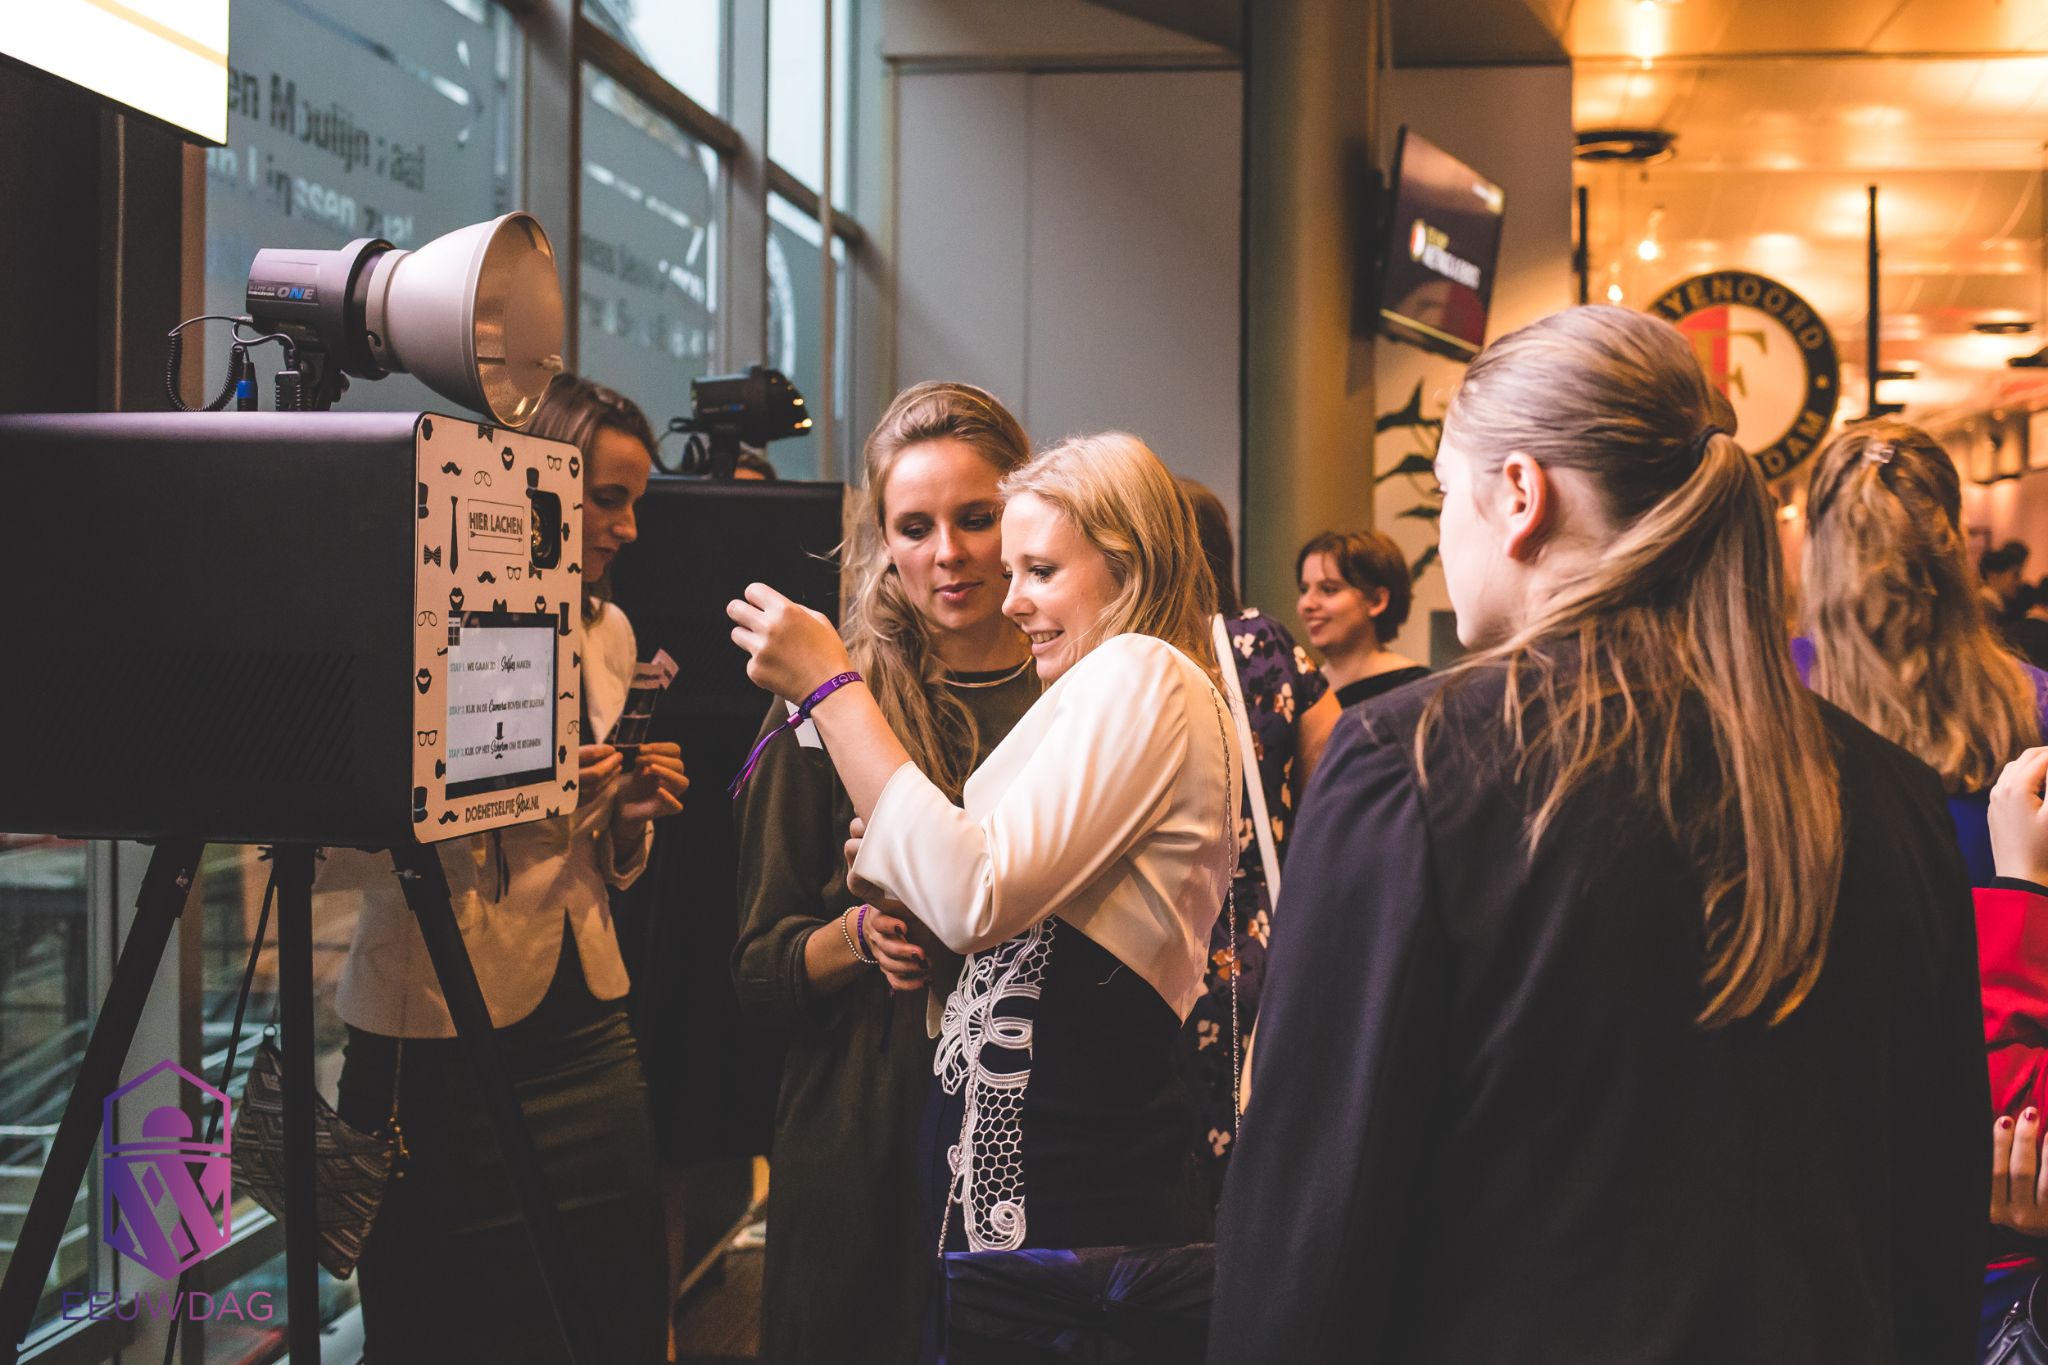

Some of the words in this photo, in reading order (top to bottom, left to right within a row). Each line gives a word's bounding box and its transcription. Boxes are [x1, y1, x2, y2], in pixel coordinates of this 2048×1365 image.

[277, 286, 314, 300] ONE
[1661, 278, 1825, 350] YENOORD
[1763, 410, 1825, 474] DAM
[469, 511, 489, 531] HIER
[490, 513, 523, 535] LACHEN
